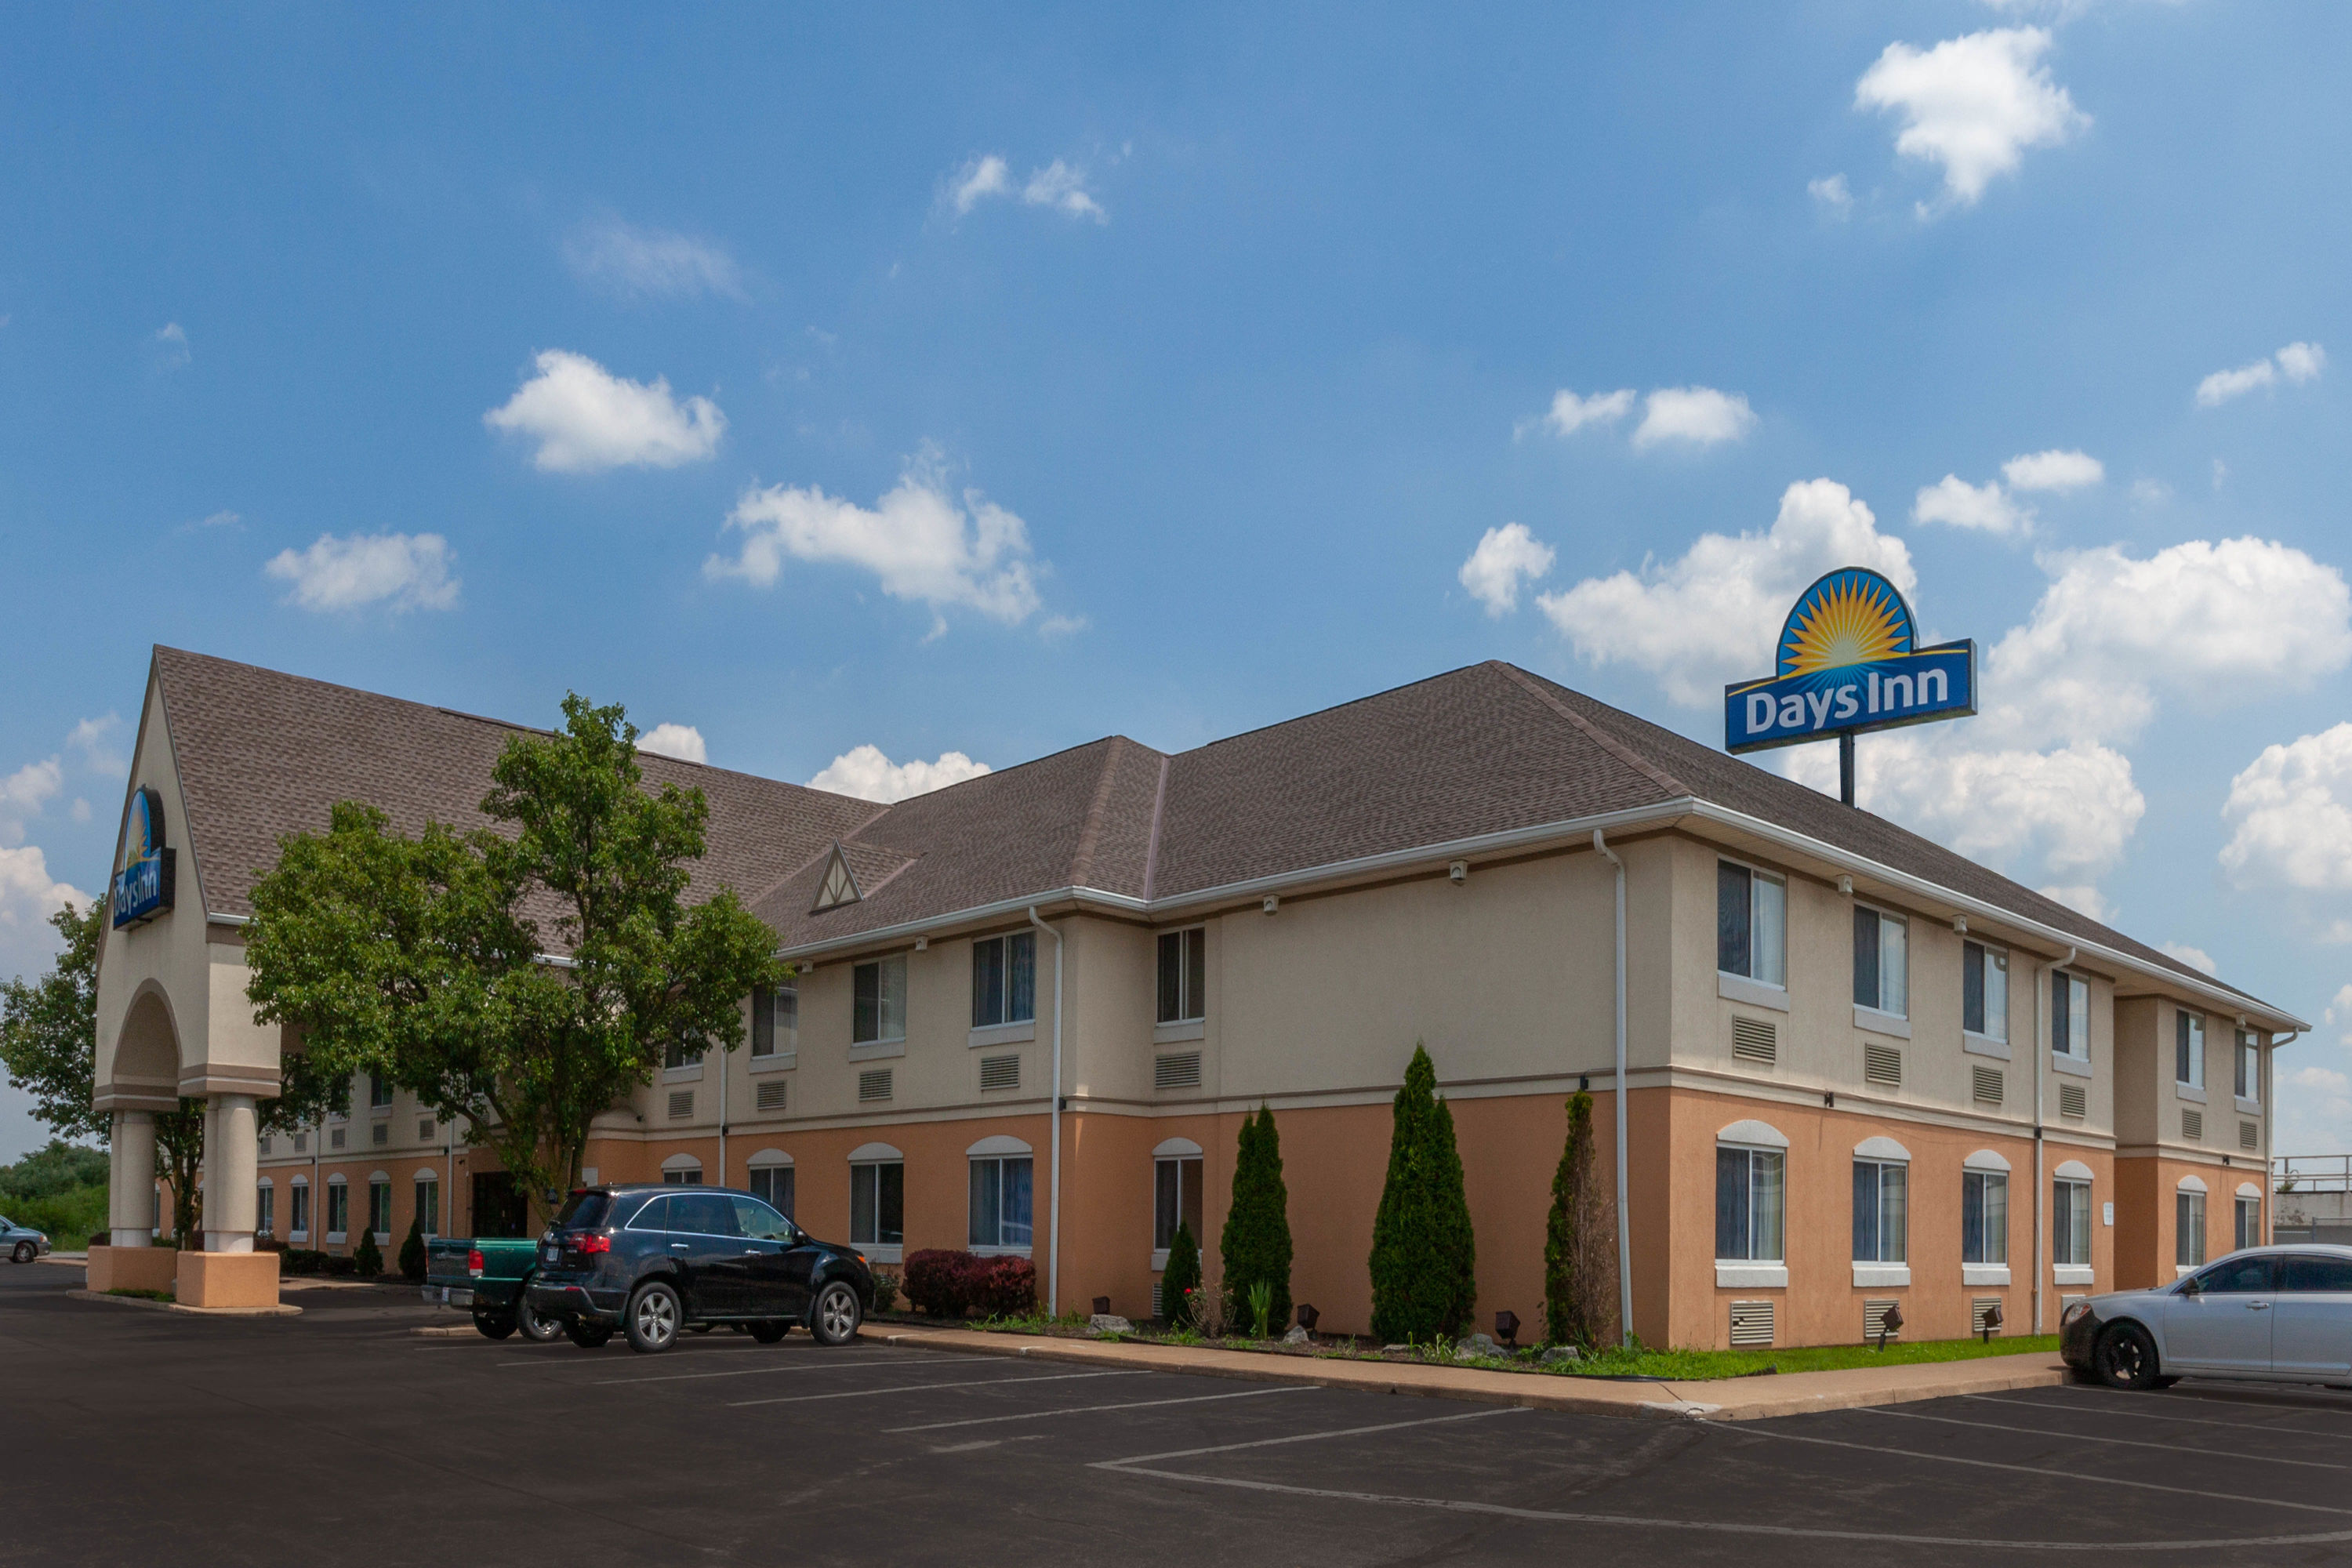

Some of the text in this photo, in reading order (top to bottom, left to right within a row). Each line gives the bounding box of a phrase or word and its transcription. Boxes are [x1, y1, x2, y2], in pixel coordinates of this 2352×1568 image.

[1746, 668, 1948, 735] Days Inn
[114, 870, 157, 916] Days Inn
